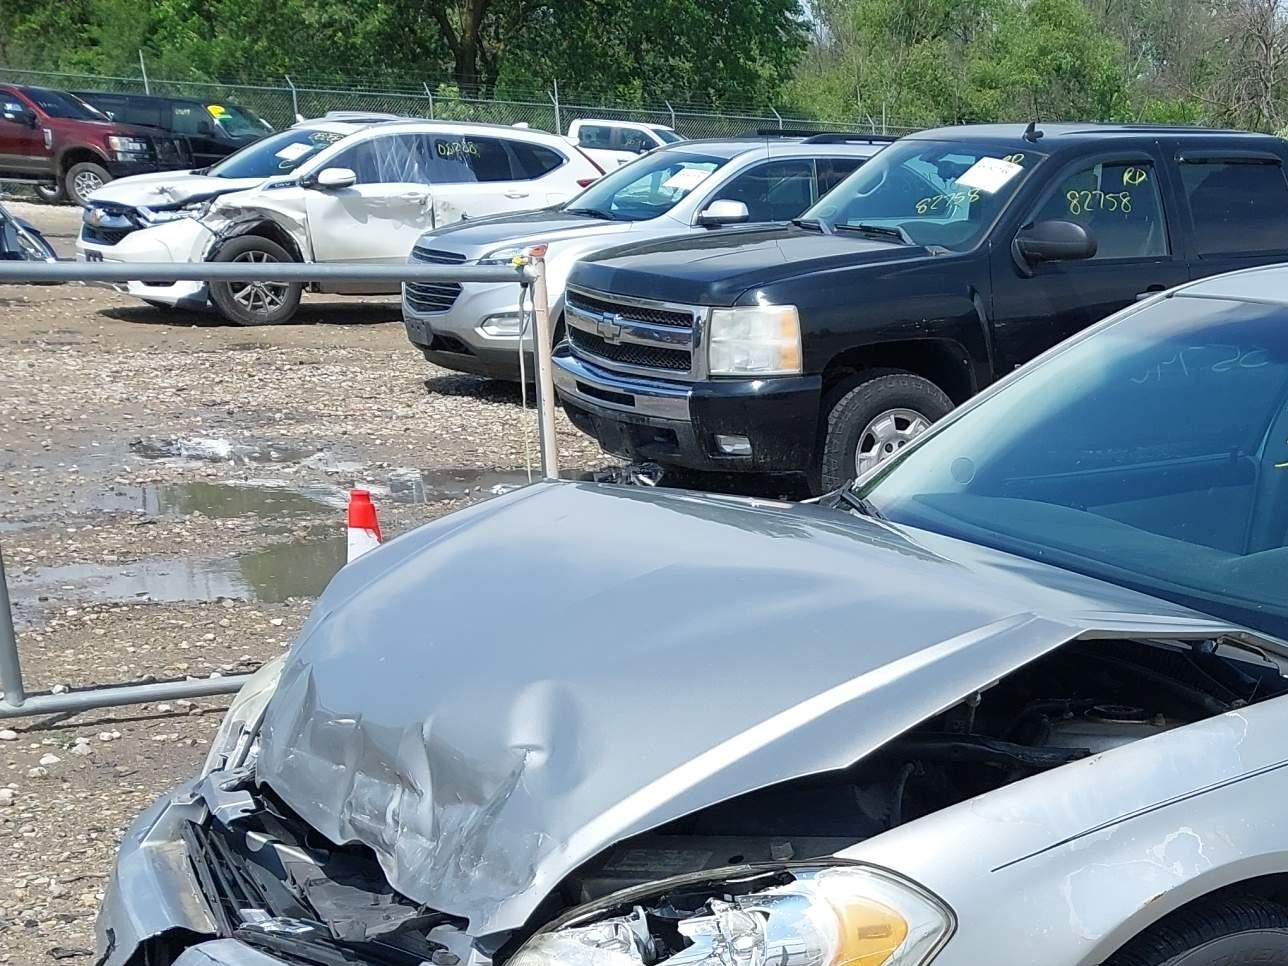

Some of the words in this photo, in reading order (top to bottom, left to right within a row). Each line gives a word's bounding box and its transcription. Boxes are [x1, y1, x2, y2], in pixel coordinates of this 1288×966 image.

[1122, 167, 1148, 187] RD
[915, 188, 981, 215] 82758
[1066, 190, 1132, 215] 82758
